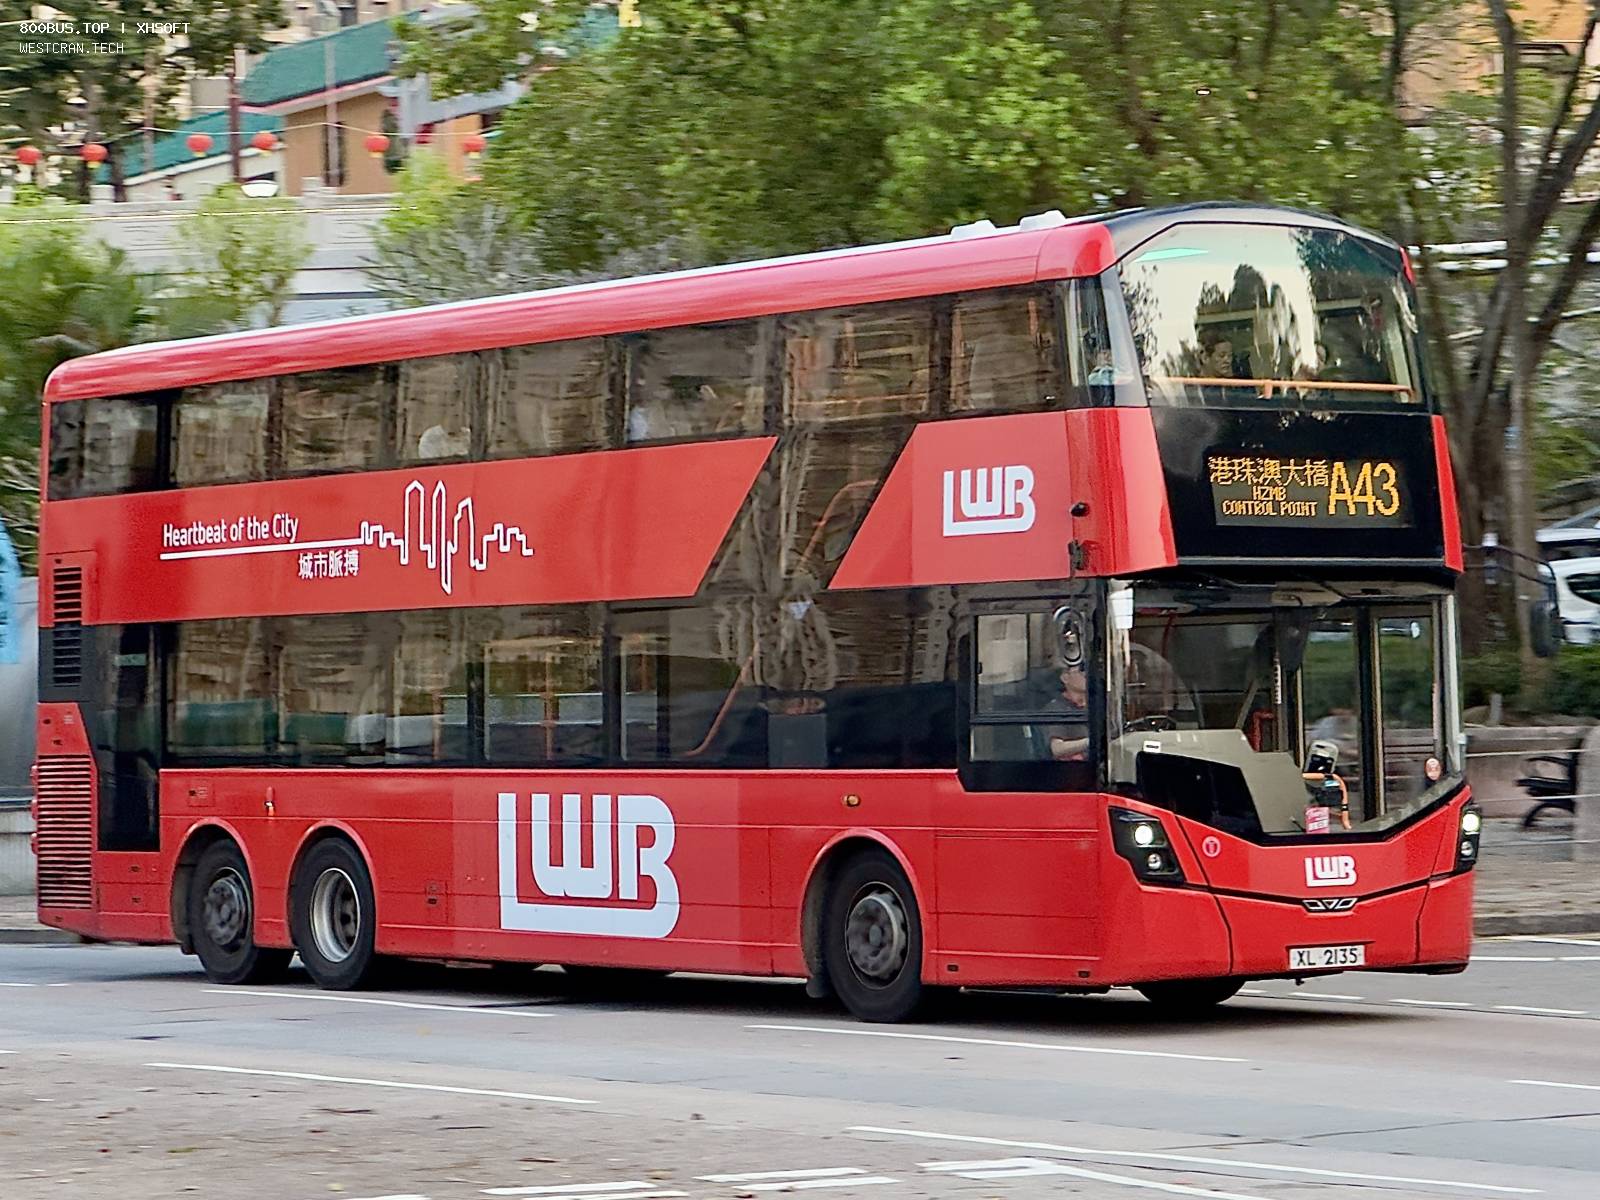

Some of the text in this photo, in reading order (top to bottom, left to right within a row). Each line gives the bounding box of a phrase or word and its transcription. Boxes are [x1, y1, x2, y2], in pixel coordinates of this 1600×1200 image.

[1208, 456, 1329, 487] 港珠澳大橋
[943, 465, 1036, 537] LWB
[1252, 485, 1287, 501] HZMB
[1328, 461, 1400, 516] A43
[1222, 500, 1318, 517] CONTROL POINT
[163, 512, 299, 547] Heartbeat of the City
[298, 548, 359, 580] 城市脈搏
[498, 792, 680, 939] LWB
[1304, 855, 1357, 887] LWB
[1296, 947, 1358, 966] XL 2135
